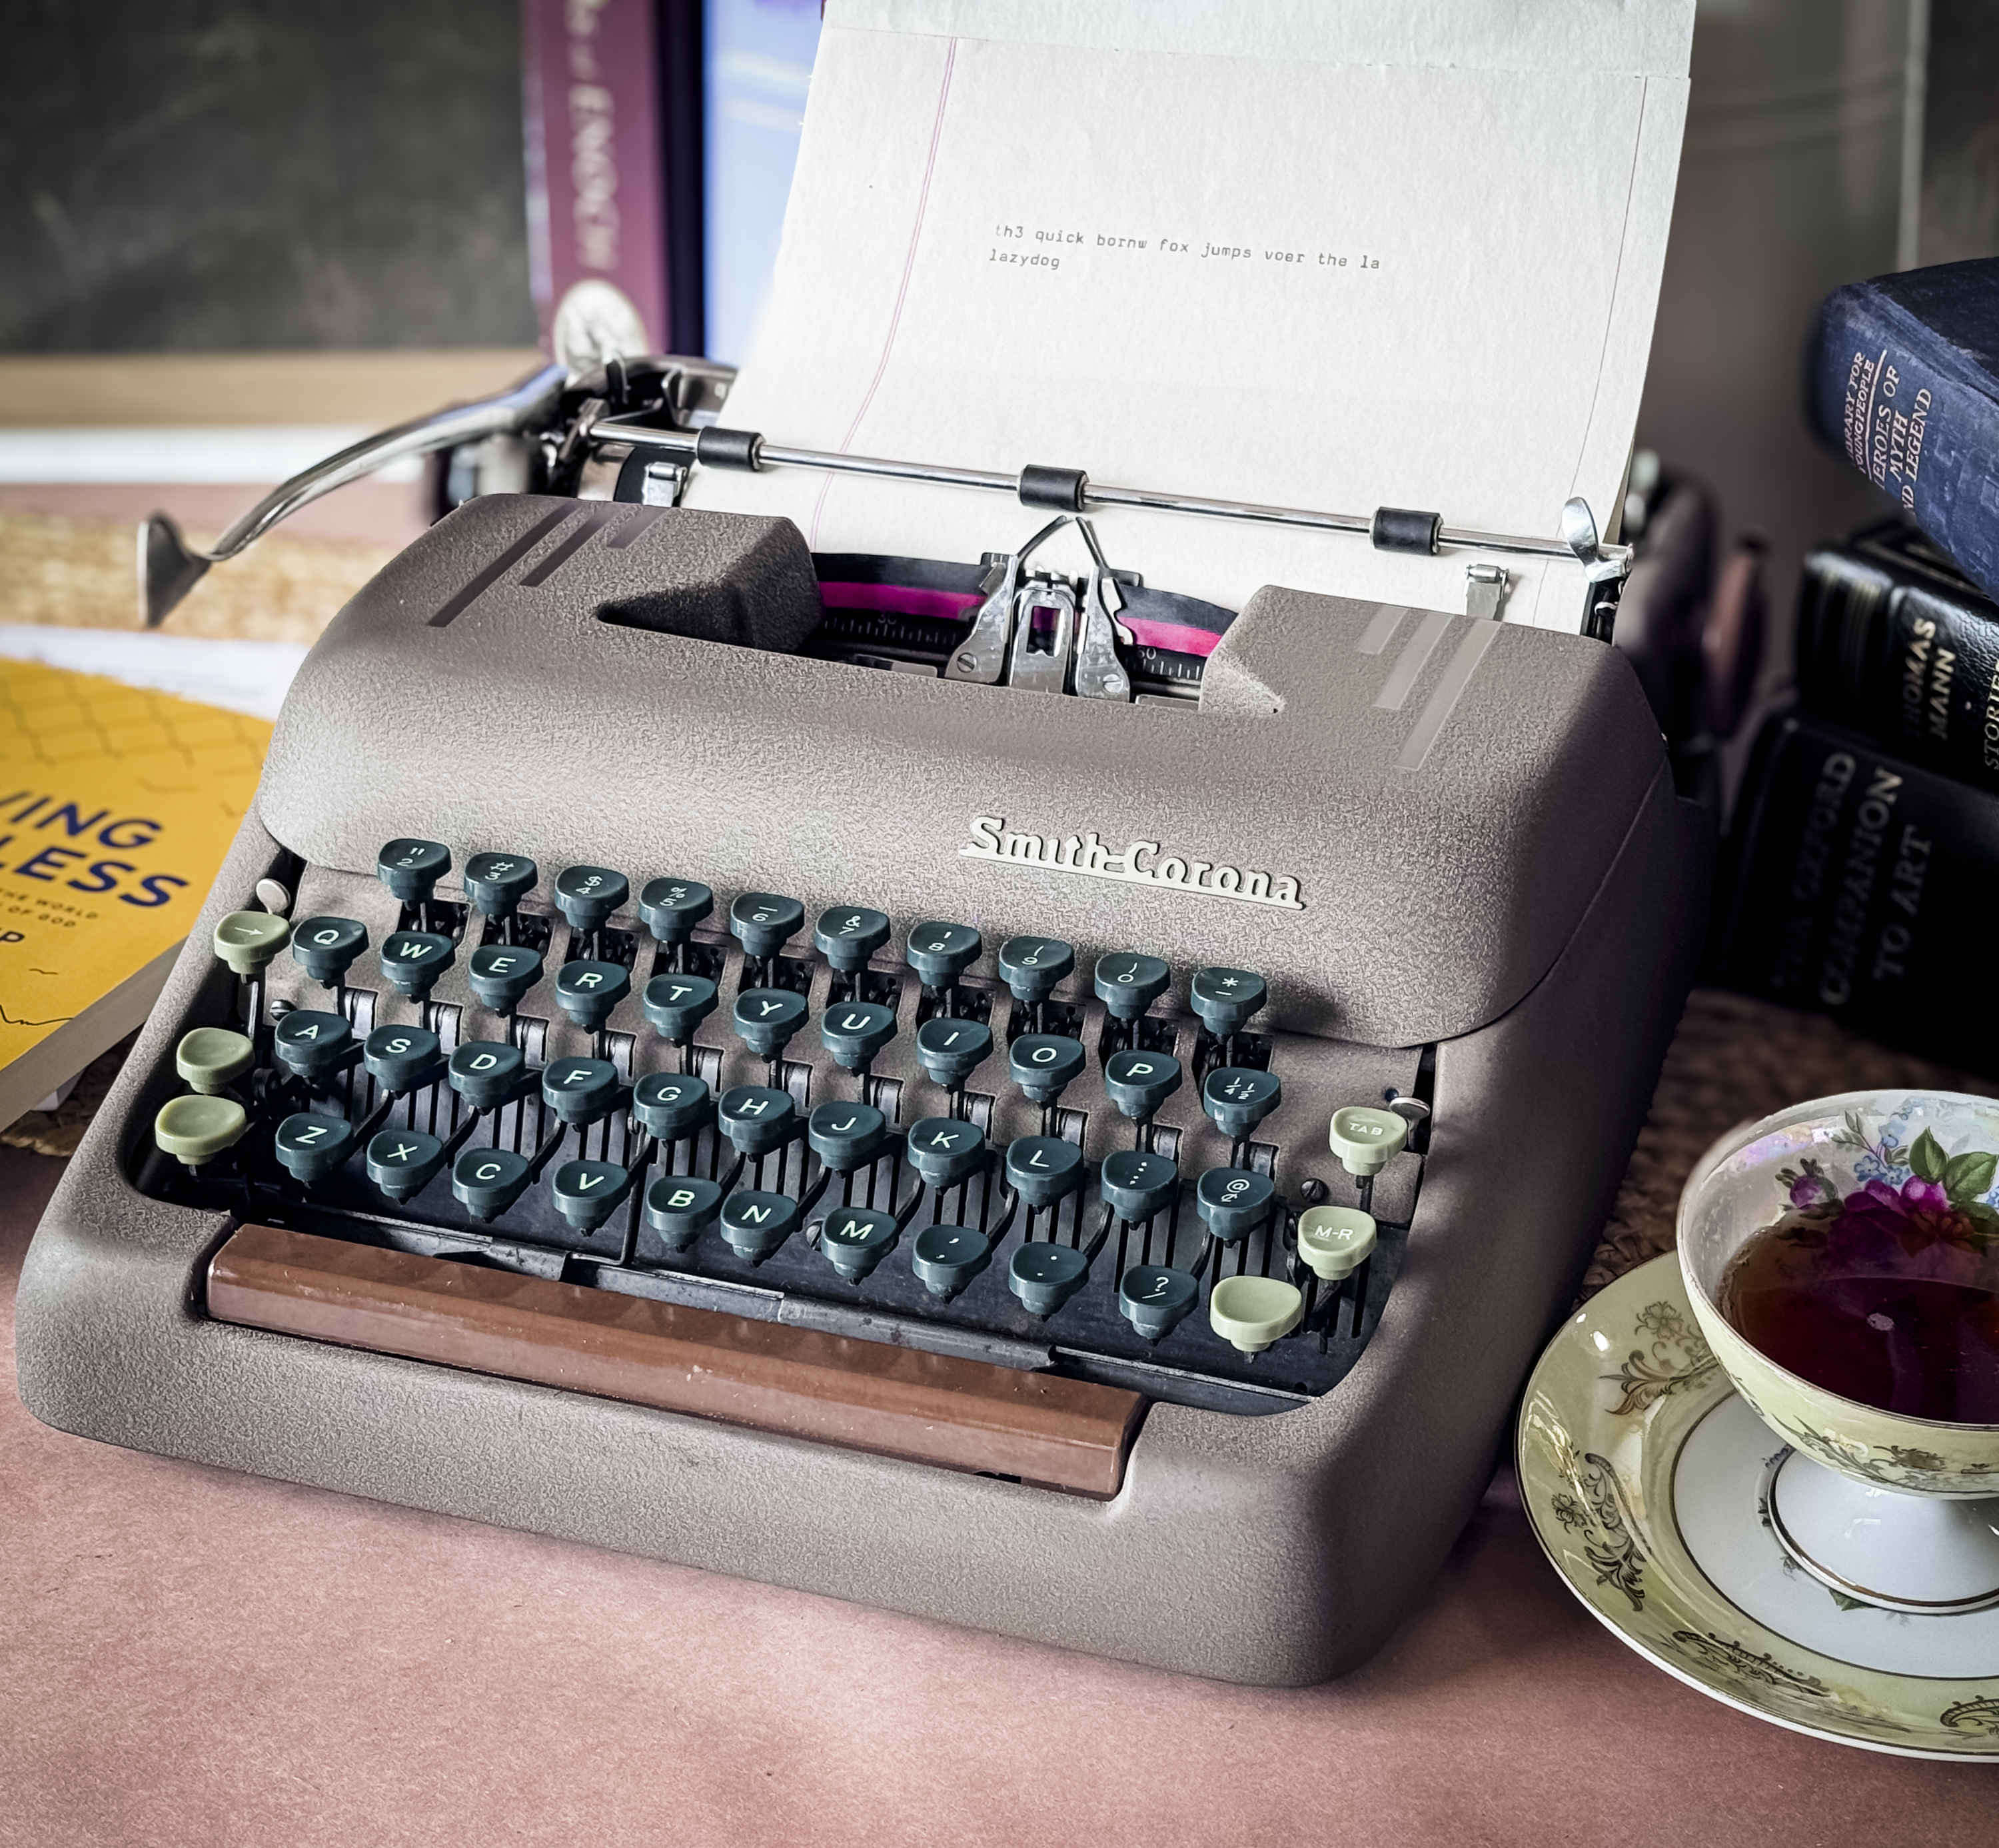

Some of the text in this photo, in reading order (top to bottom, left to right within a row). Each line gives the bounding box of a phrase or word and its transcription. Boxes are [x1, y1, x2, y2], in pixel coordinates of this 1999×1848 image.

[996, 223, 1380, 269] th3 quick bornw fox jumps voer the la
[989, 249, 1060, 271] lazydog
[1883, 365, 1900, 398] OF
[1890, 410, 1908, 482] MYTH
[1902, 389, 1932, 514] ND LEGEND
[1928, 647, 1956, 741] MANN
[1984, 657, 1999, 770] STORIE
[959, 816, 1307, 910] Smith-Corona
[313, 929, 340, 946] Q
[400, 942, 432, 958] W
[488, 957, 516, 973] E
[574, 972, 603, 988] R
[670, 985, 693, 1001] T
[760, 1000, 784, 1016] Y
[842, 1013, 871, 1030] U
[295, 1024, 319, 1040] A
[385, 1038, 411, 1054] S
[1031, 1047, 1057, 1062] O
[469, 1054, 497, 1070] D
[1126, 1062, 1153, 1077] P
[563, 1070, 592, 1084] F
[657, 1086, 682, 1101] G
[738, 1098, 769, 1115] H
[831, 1117, 857, 1131] J
[1349, 1122, 1383, 1136] TAB
[295, 1126, 328, 1144] Z
[930, 1132, 960, 1148] K
[387, 1143, 418, 1161] X
[1029, 1150, 1049, 1168] L
[476, 1163, 501, 1180] C
[579, 1173, 604, 1190] V
[667, 1190, 695, 1207] B
[741, 1205, 772, 1223] N
[840, 1220, 874, 1240] M
[1315, 1225, 1354, 1241] M-R
